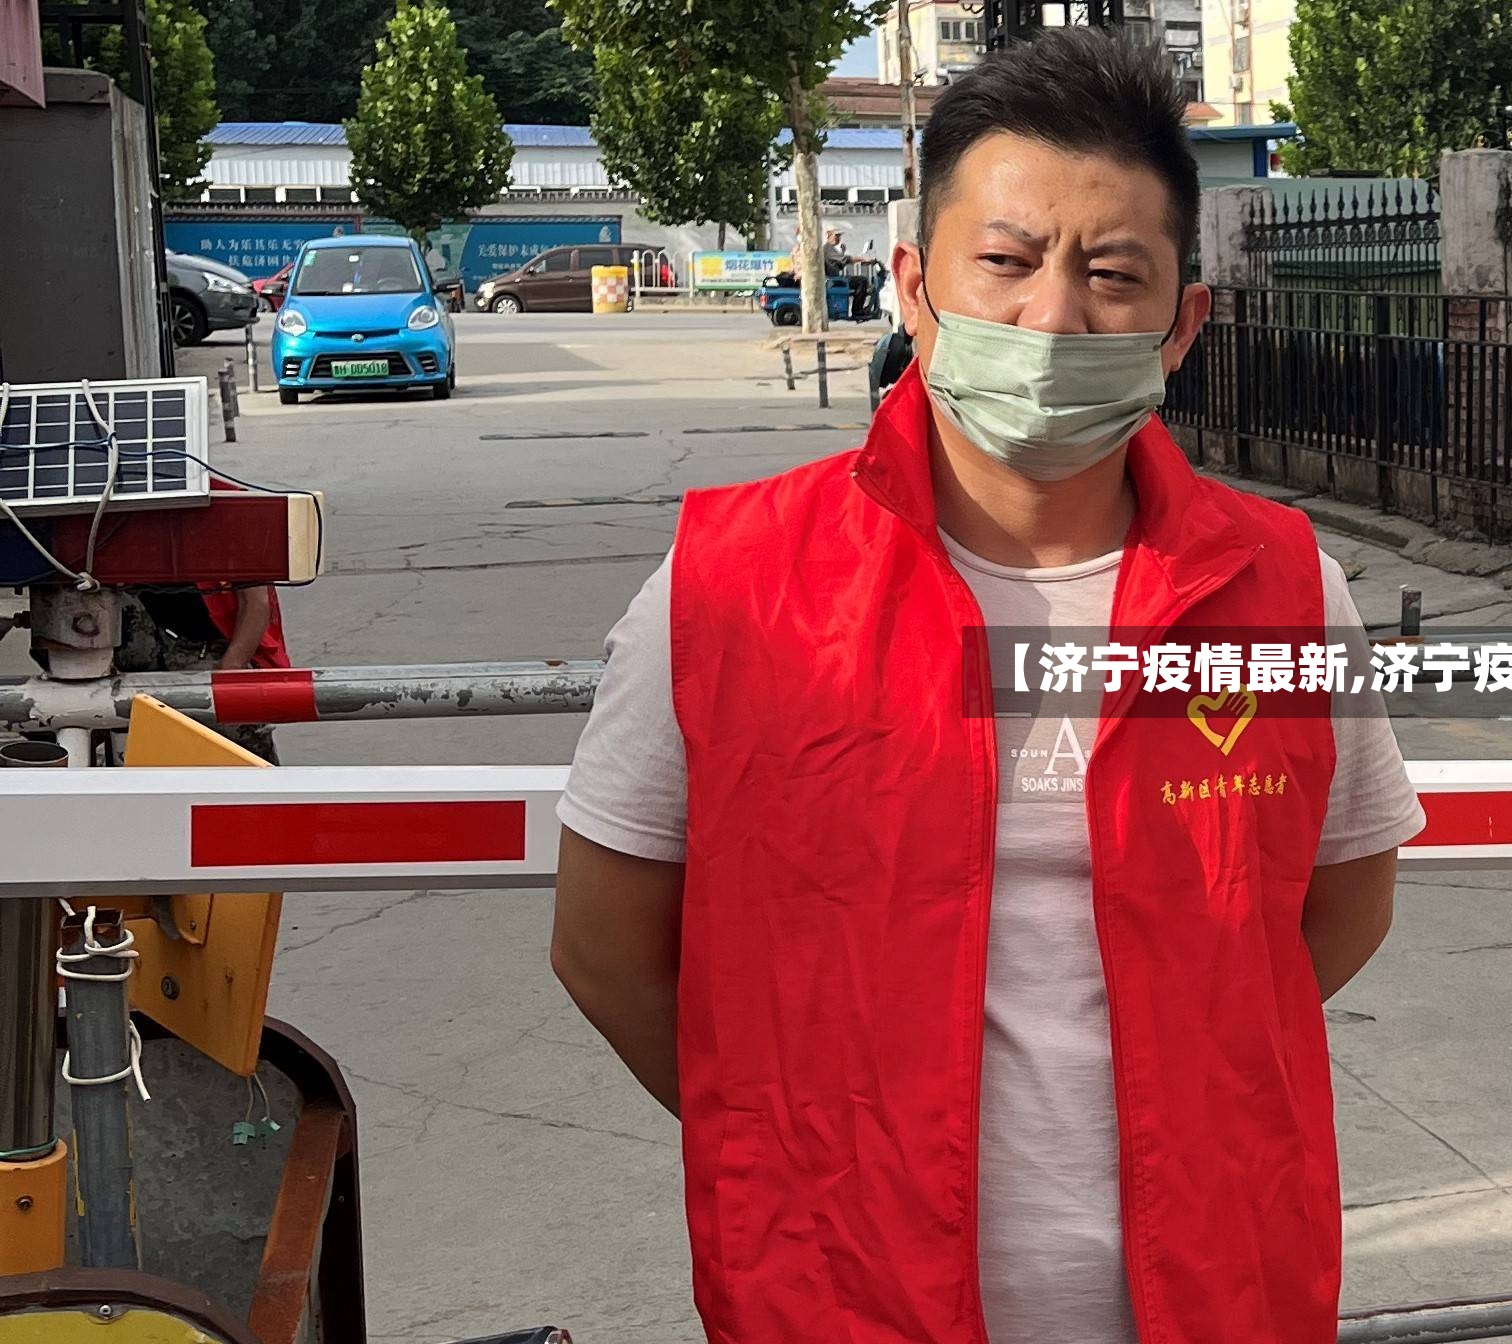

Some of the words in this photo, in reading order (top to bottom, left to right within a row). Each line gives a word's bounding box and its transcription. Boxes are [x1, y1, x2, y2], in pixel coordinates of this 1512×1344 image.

[1021, 777, 1059, 793] SOAKS
[1160, 772, 1289, 806] 高新区青年志愿者
